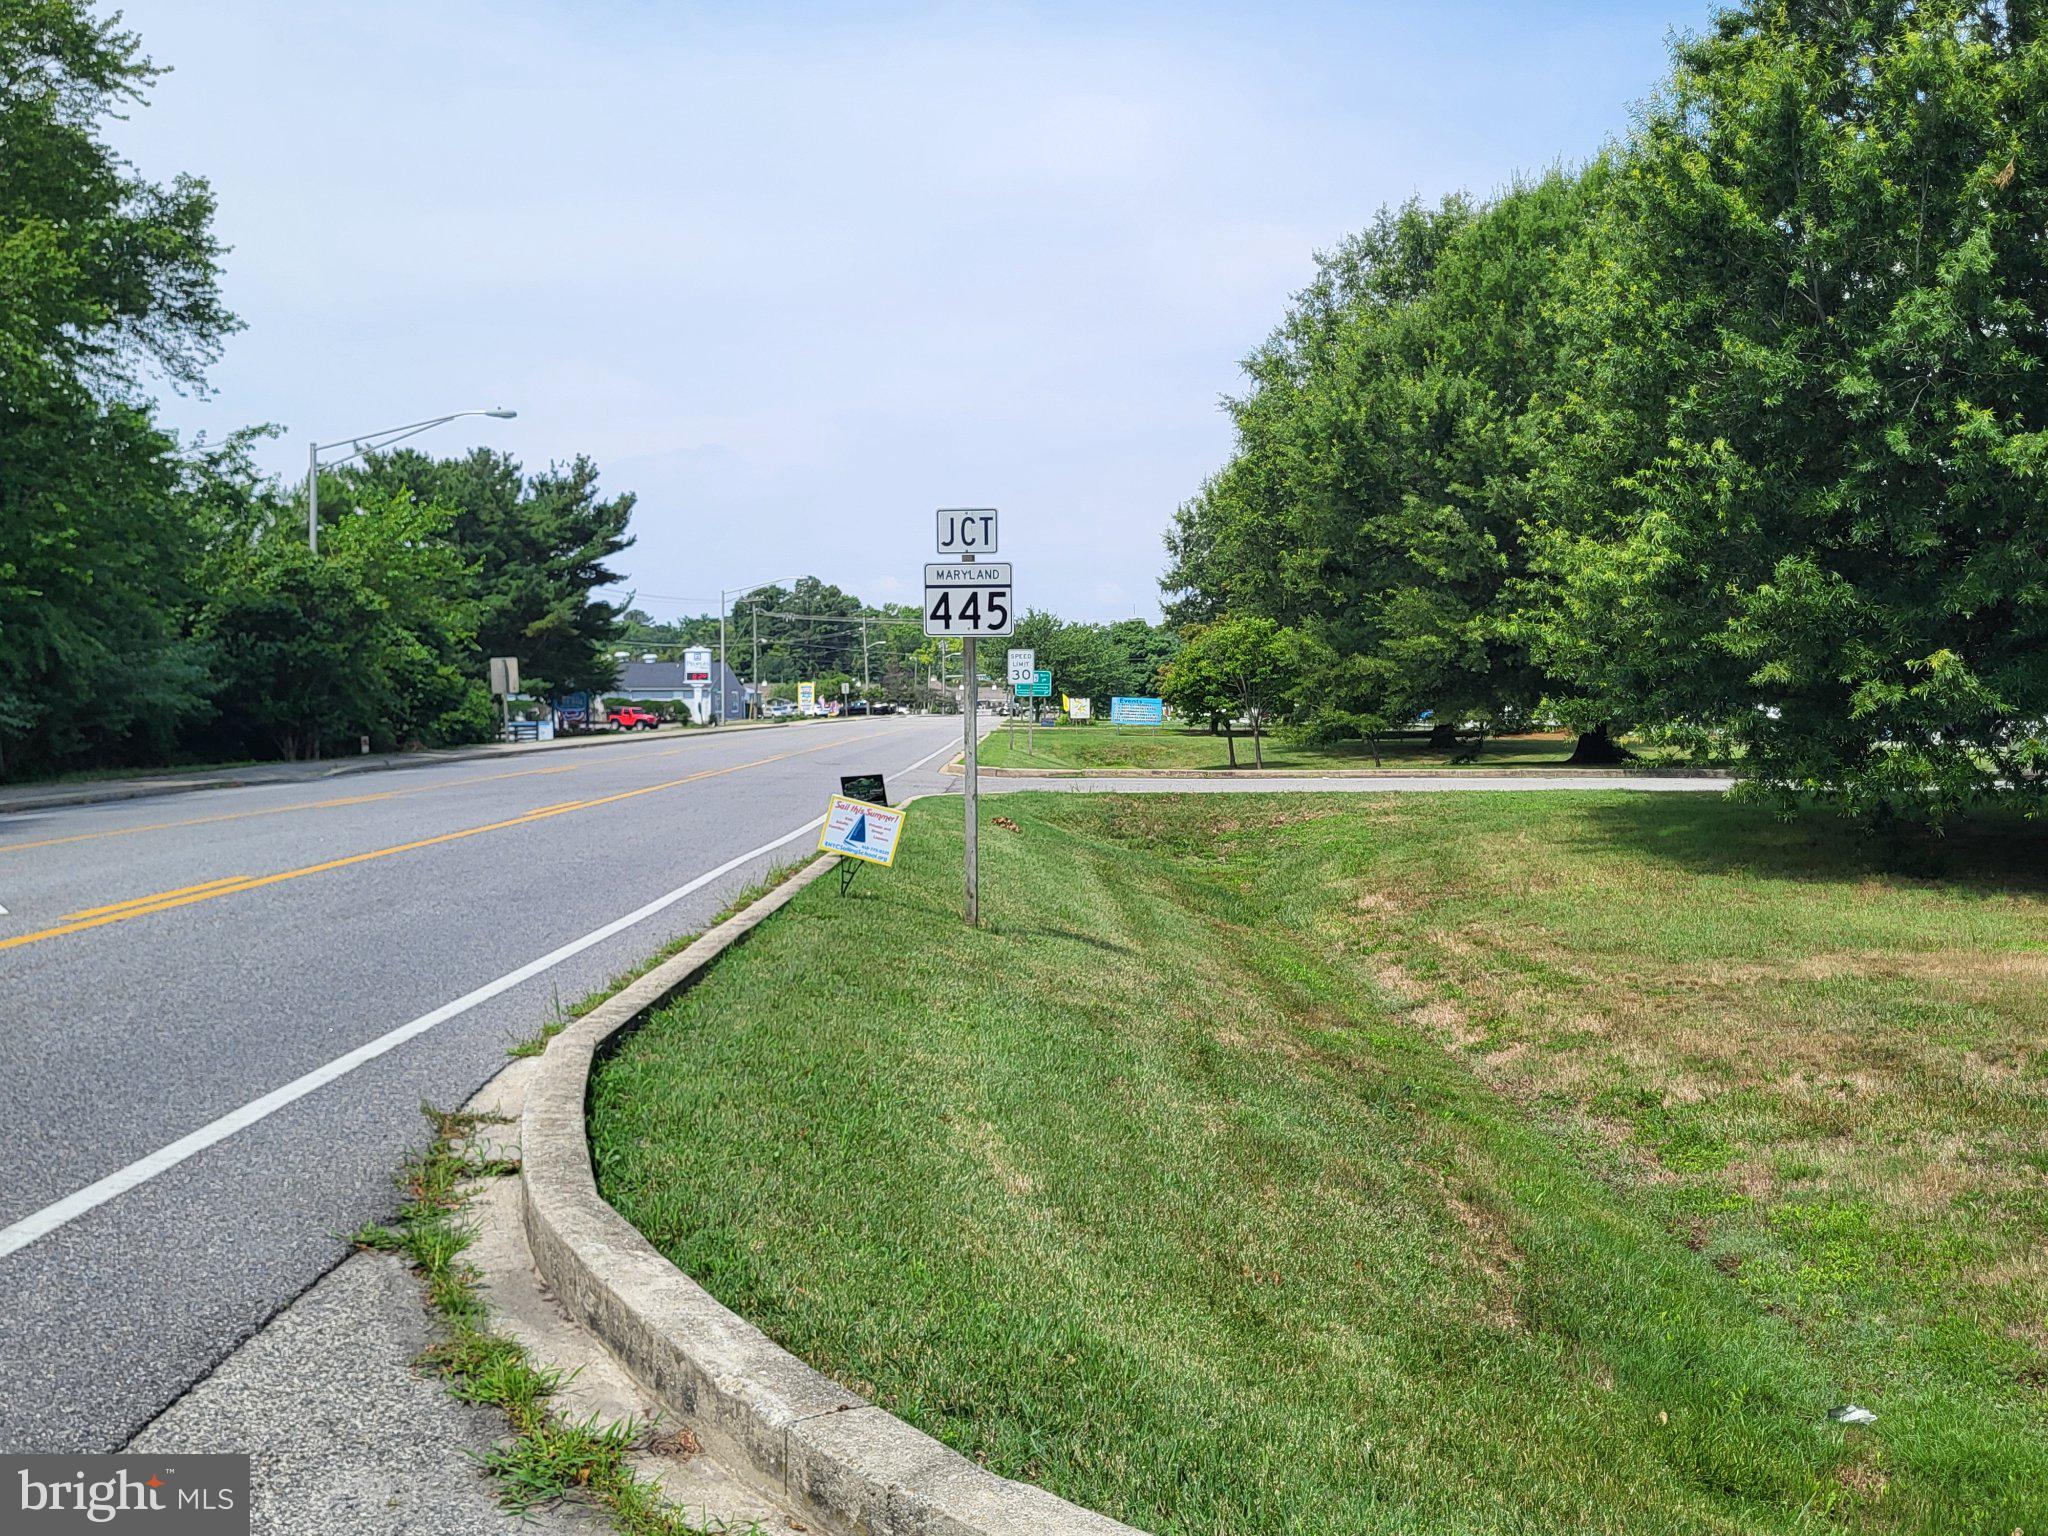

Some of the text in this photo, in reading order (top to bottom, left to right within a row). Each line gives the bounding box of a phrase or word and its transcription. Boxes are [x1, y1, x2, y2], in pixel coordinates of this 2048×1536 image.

[941, 516, 994, 547] JCT
[936, 569, 1000, 580] MARYLAND
[929, 591, 1008, 630] 445
[1011, 669, 1031, 681] 30
[835, 800, 899, 823] Sail this Summer!
